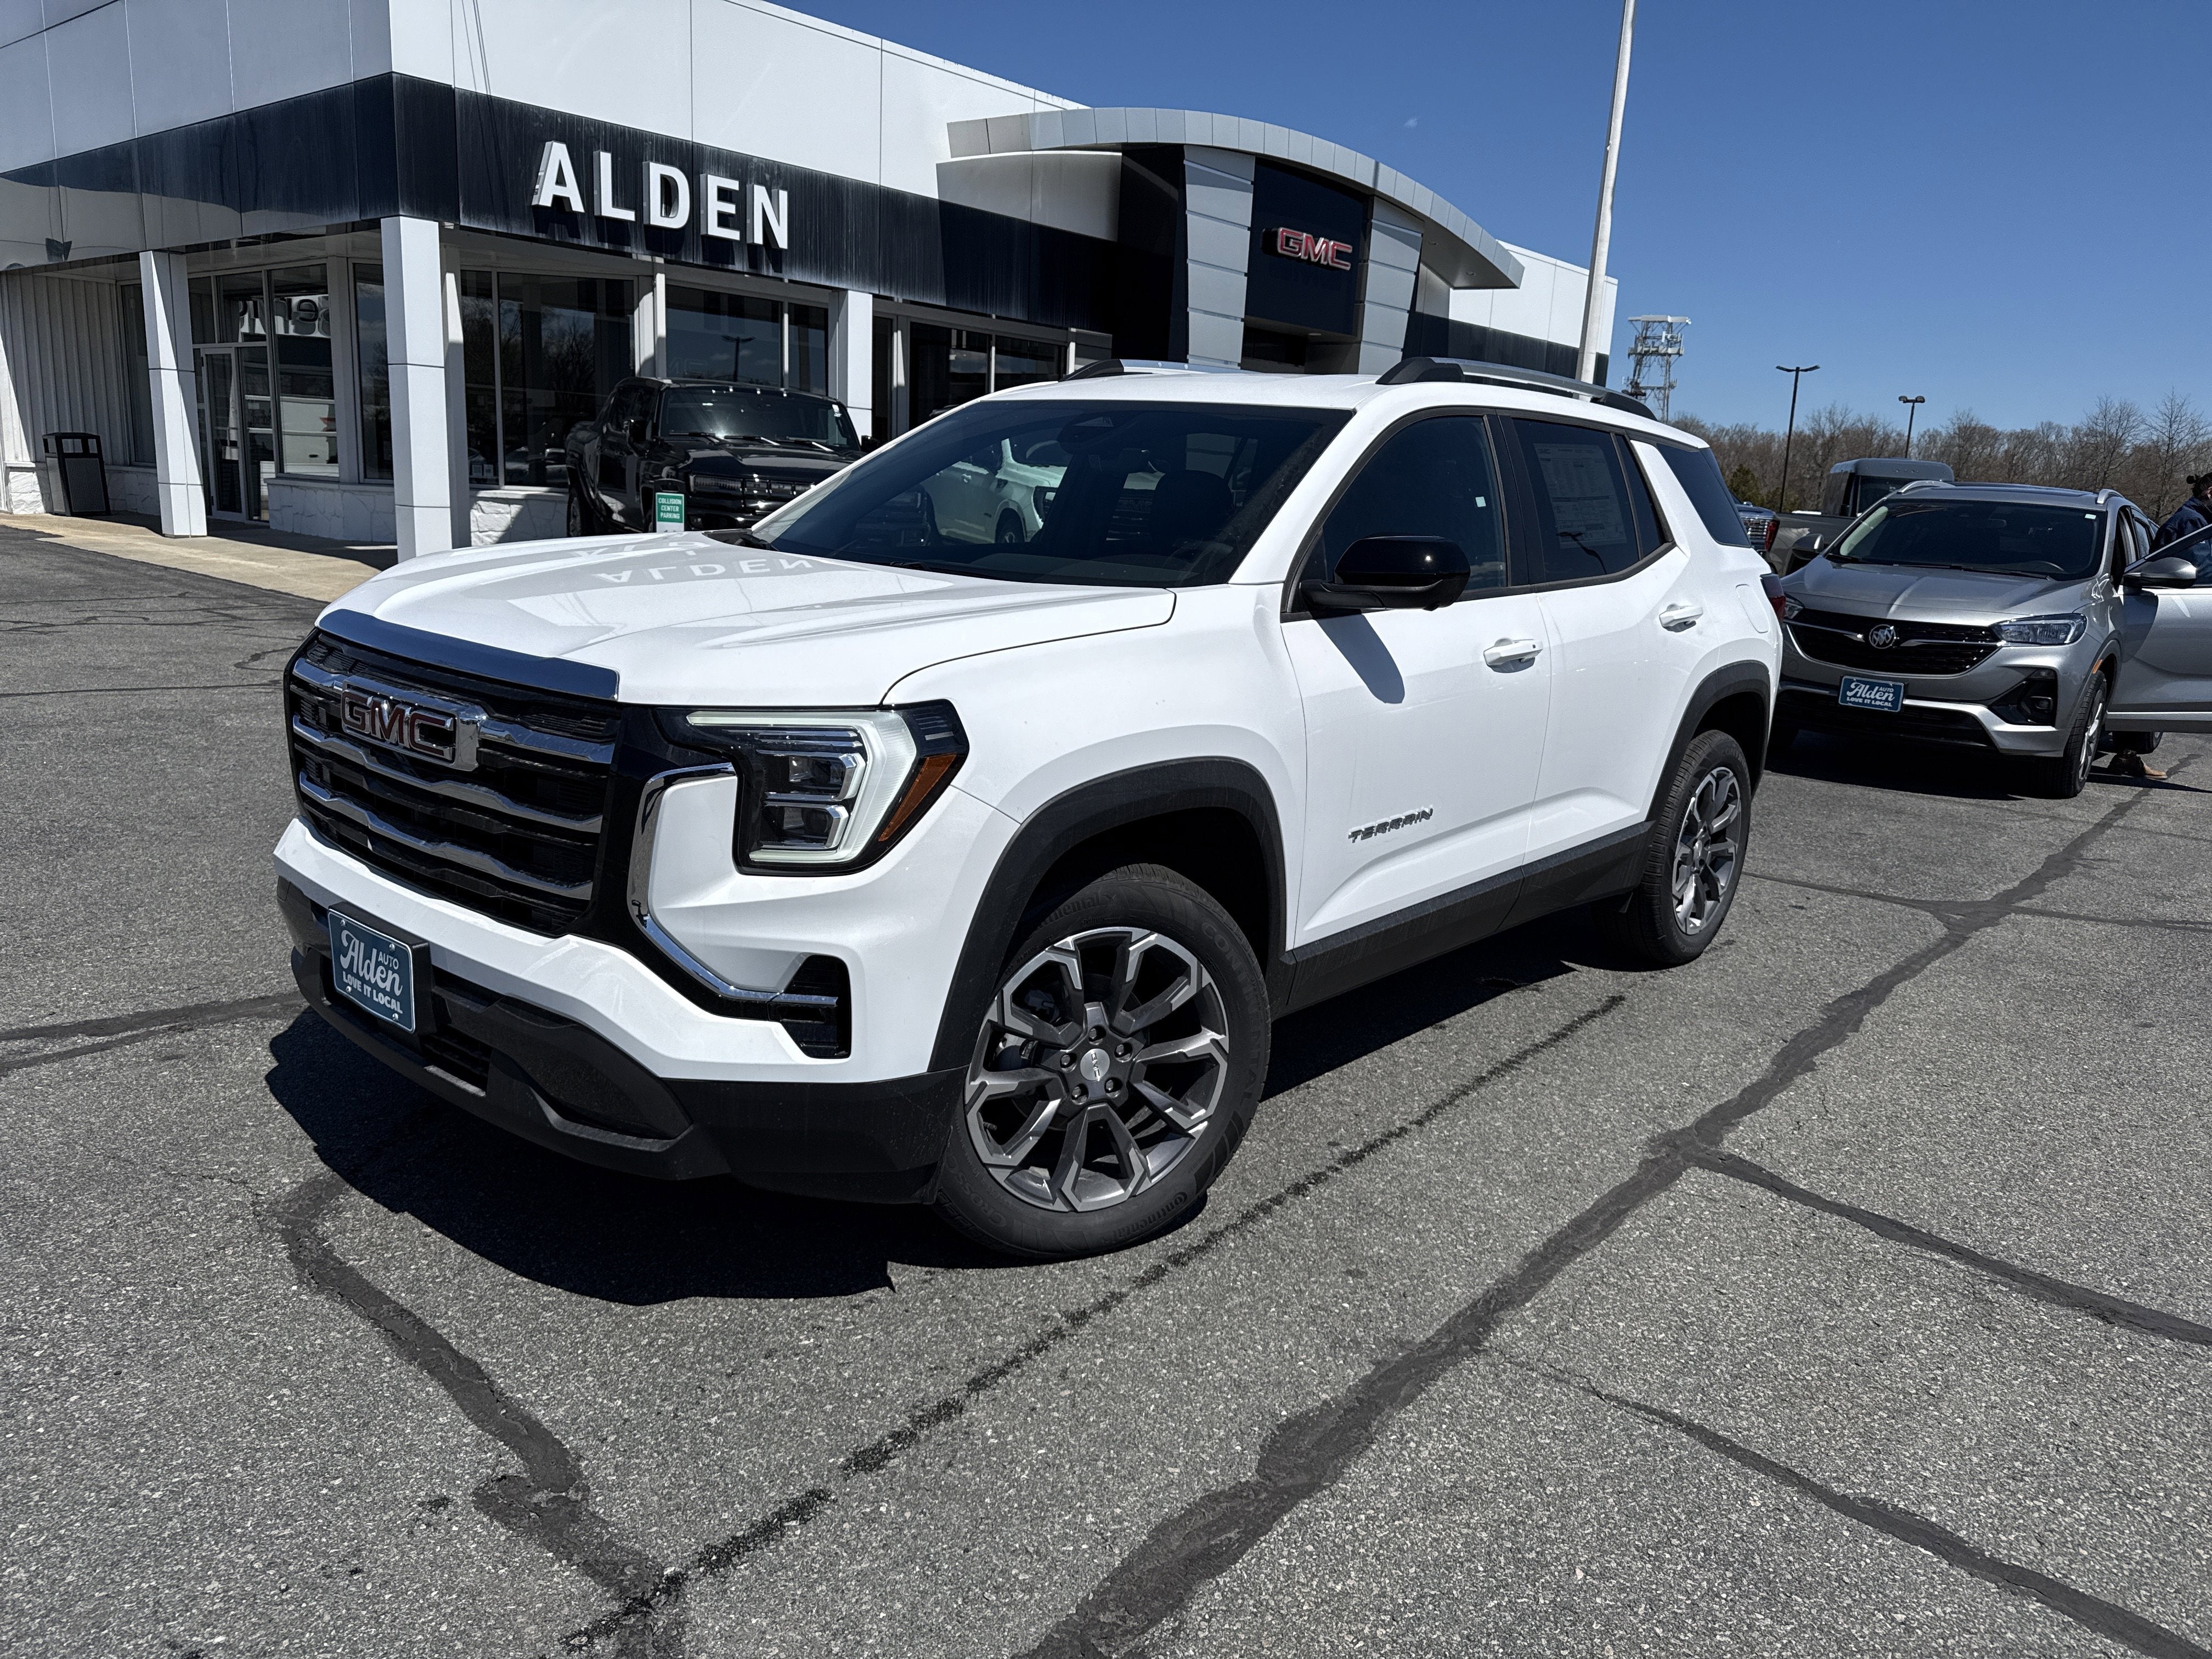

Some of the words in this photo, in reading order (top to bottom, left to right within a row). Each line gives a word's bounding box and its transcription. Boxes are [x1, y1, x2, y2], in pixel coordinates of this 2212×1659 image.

[531, 140, 788, 250] ALDEN
[1277, 227, 1353, 270] GMC
[1846, 682, 1895, 702] Alden
[341, 688, 455, 761] GMC
[1348, 808, 1433, 843] TERRAIN
[340, 929, 403, 996] Alden
[378, 951, 399, 970] AUTO
[342, 971, 362, 992] LOVE
[364, 984, 371, 998] IT
[373, 990, 403, 1014] LOCAL
[1201, 922, 1261, 1107] CONTINENTAL
[1115, 1191, 1187, 1239] Continental
